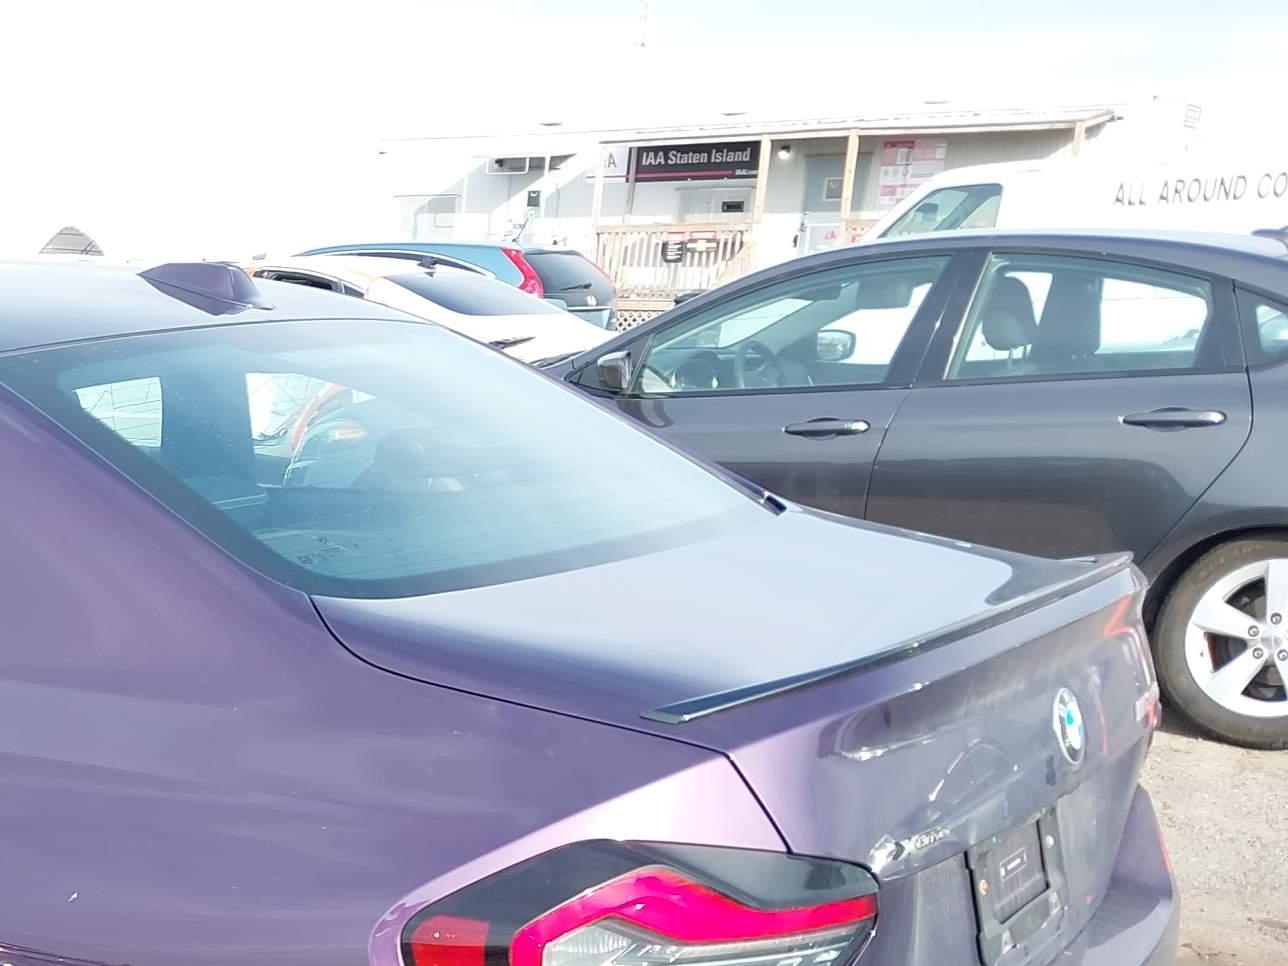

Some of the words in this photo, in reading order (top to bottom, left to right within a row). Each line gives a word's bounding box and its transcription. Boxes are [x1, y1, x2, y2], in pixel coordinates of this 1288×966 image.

[642, 151, 665, 166] IAA
[668, 149, 708, 165] Staten
[711, 147, 751, 163] Island
[1113, 181, 1147, 206] ALL
[1158, 175, 1248, 204] AROUND
